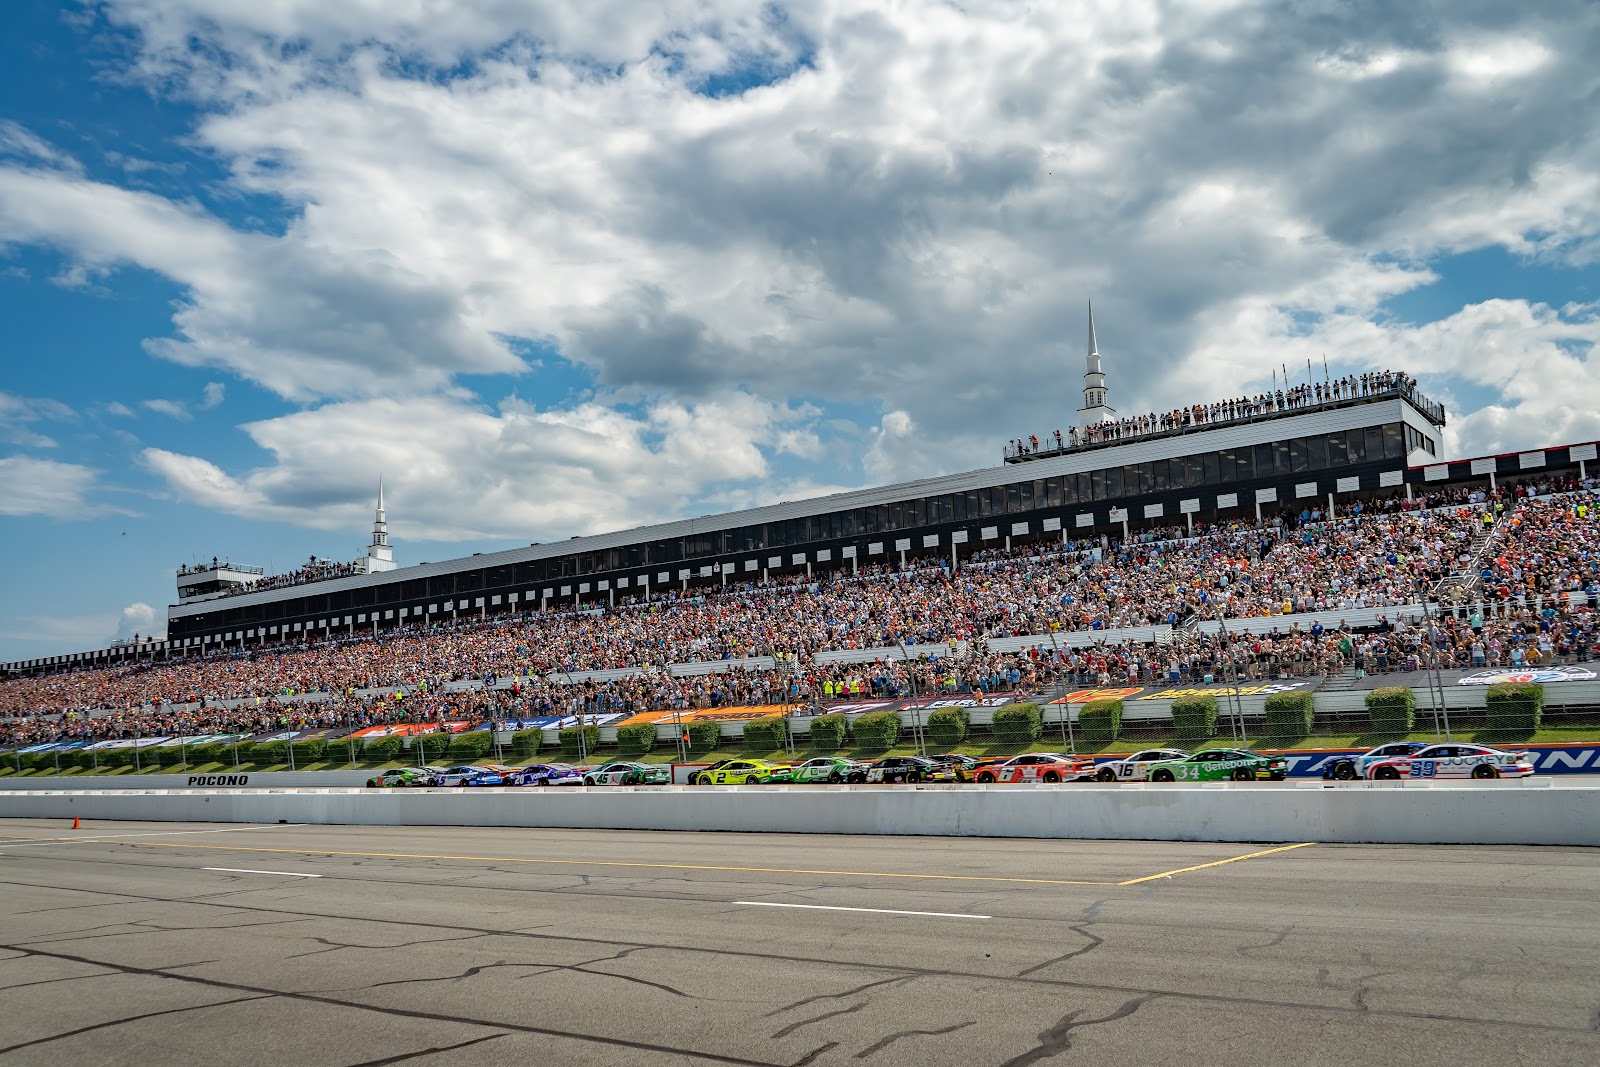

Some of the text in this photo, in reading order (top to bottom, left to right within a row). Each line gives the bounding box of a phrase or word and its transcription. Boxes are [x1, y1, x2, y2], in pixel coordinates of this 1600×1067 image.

[1442, 755, 1506, 766] JOCKEY
[1118, 764, 1134, 776] 16
[1177, 764, 1199, 779] 34
[1410, 760, 1435, 778] 99
[188, 775, 248, 786] POCONO
[438, 774, 446, 786] 5
[514, 774, 525, 784] 20
[596, 773, 609, 784] 45
[716, 772, 726, 783] 2
[866, 768, 885, 782] 54
